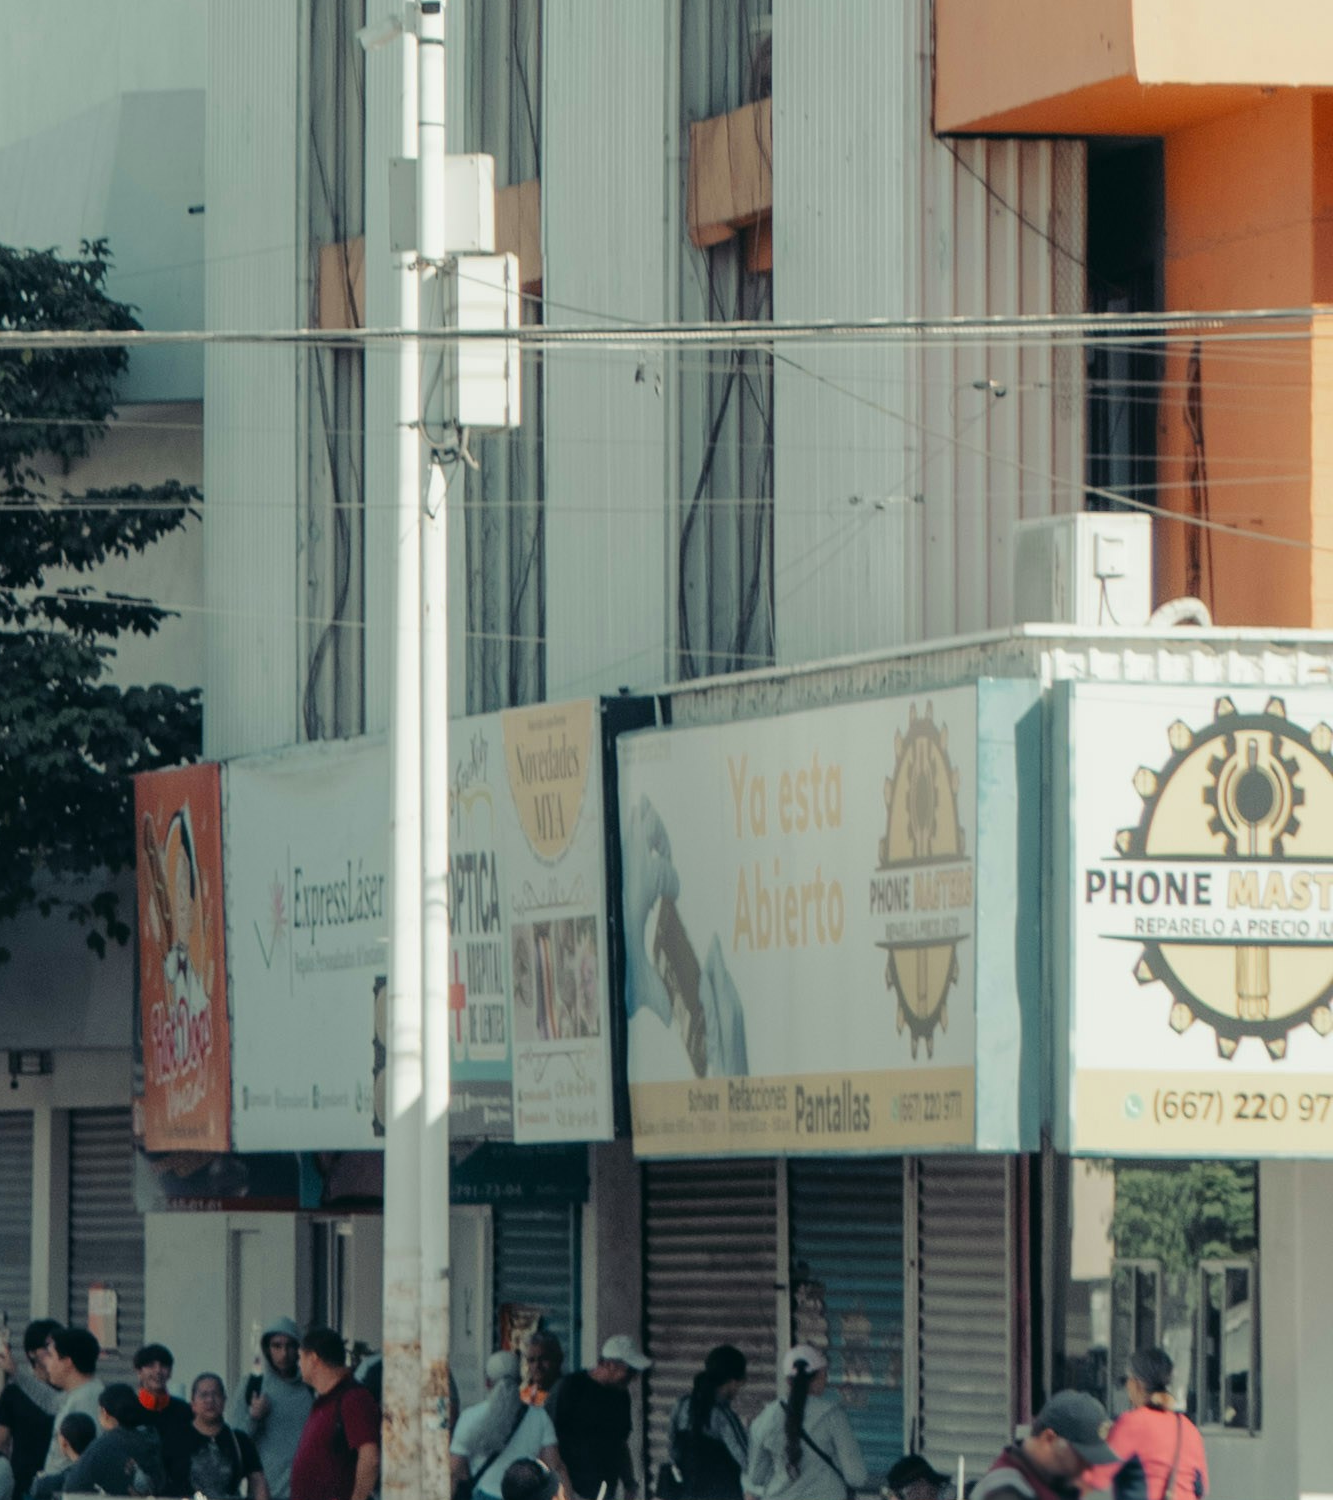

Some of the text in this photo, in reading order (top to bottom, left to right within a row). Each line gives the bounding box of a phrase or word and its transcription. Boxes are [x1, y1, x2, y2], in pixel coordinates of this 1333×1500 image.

[516, 732, 581, 787] Novedades
[533, 791, 566, 842] MYA
[727, 750, 843, 838] Ya esta
[294, 856, 385, 946] ExpressLáser
[733, 856, 845, 952] Abierto
[869, 873, 910, 916] PHONE
[1085, 869, 1212, 906] PHONE
[1134, 917, 1225, 937] REPARELO
[1230, 919, 1243, 936] A
[1247, 918, 1310, 937] PRECIO
[728, 1079, 787, 1113] Refacciones
[795, 1080, 871, 1135] Pantallas
[1153, 1088, 1223, 1125] (667)
[1233, 1092, 1288, 1121] 220
